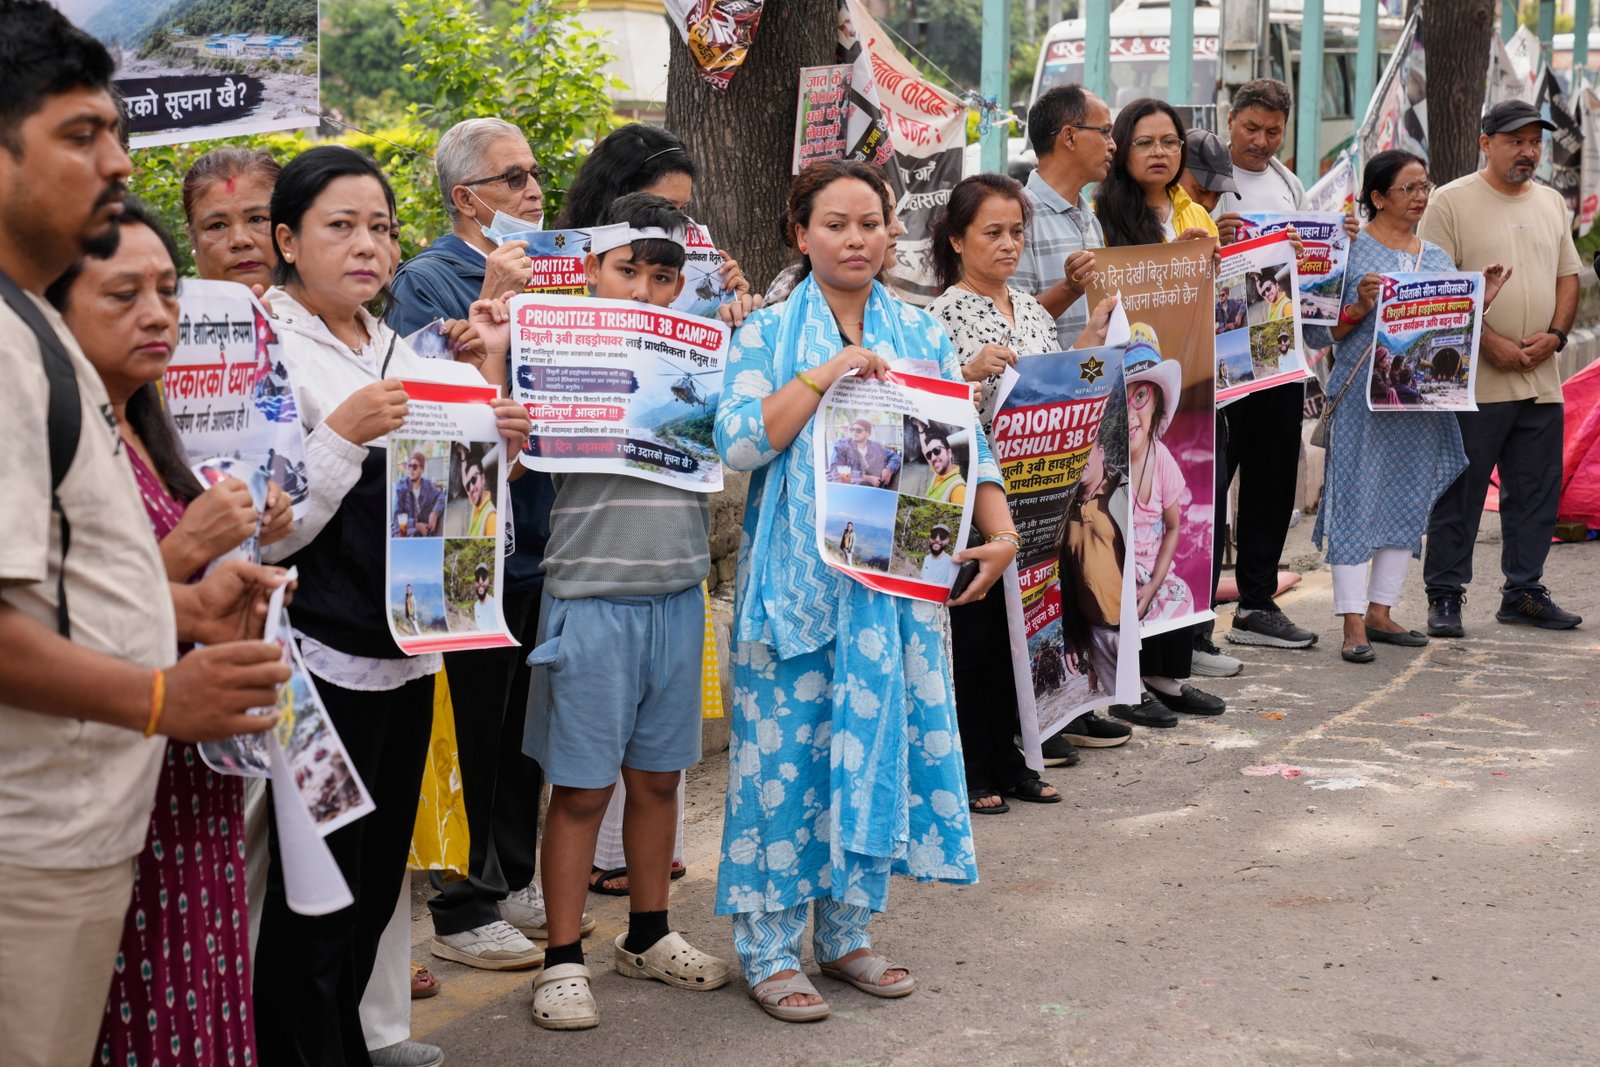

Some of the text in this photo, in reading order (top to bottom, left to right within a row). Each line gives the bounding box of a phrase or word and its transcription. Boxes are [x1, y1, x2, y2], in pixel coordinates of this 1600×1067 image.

[1053, 38, 1133, 58] ROK
[1130, 37, 1146, 54] &
[164, 88, 210, 120] सूचना
[217, 78, 248, 107] खै?
[531, 259, 575, 273] IORITIZE
[1107, 264, 1124, 288] दिन
[1125, 261, 1145, 285] देखी
[1147, 259, 1169, 286] बिदुर
[1170, 255, 1197, 280] शिविर
[551, 274, 563, 285] 3B
[1152, 283, 1181, 308] सकेको
[1182, 281, 1199, 304] छैन
[194, 313, 231, 351] शान्तिपूर्ण
[525, 308, 719, 348] PRIORITIZE TRISHULI 3B CAMP!!!
[520, 328, 552, 347] त्रिशूली
[555, 331, 573, 346] ३बी
[575, 333, 624, 348] हाइड्रोपावर
[625, 337, 642, 349] लाई
[644, 340, 686, 359] प्राथमिकता
[689, 349, 709, 368] दिनुस्
[228, 361, 259, 398] ध्यान
[1075, 387, 1093, 395] NEPAL
[211, 409, 235, 432] आएका
[530, 404, 572, 419] शान्तिपूर्ण
[575, 407, 607, 418] आव्हान
[616, 444, 622, 453] र
[623, 442, 636, 454] पनि
[664, 453, 681, 466] सूचना
[996, 433, 1061, 460] RISHULI
[1063, 428, 1085, 450] 3B
[1048, 447, 1093, 471] हाइड्रोपाव
[1010, 471, 1064, 491] प्राथमिकता
